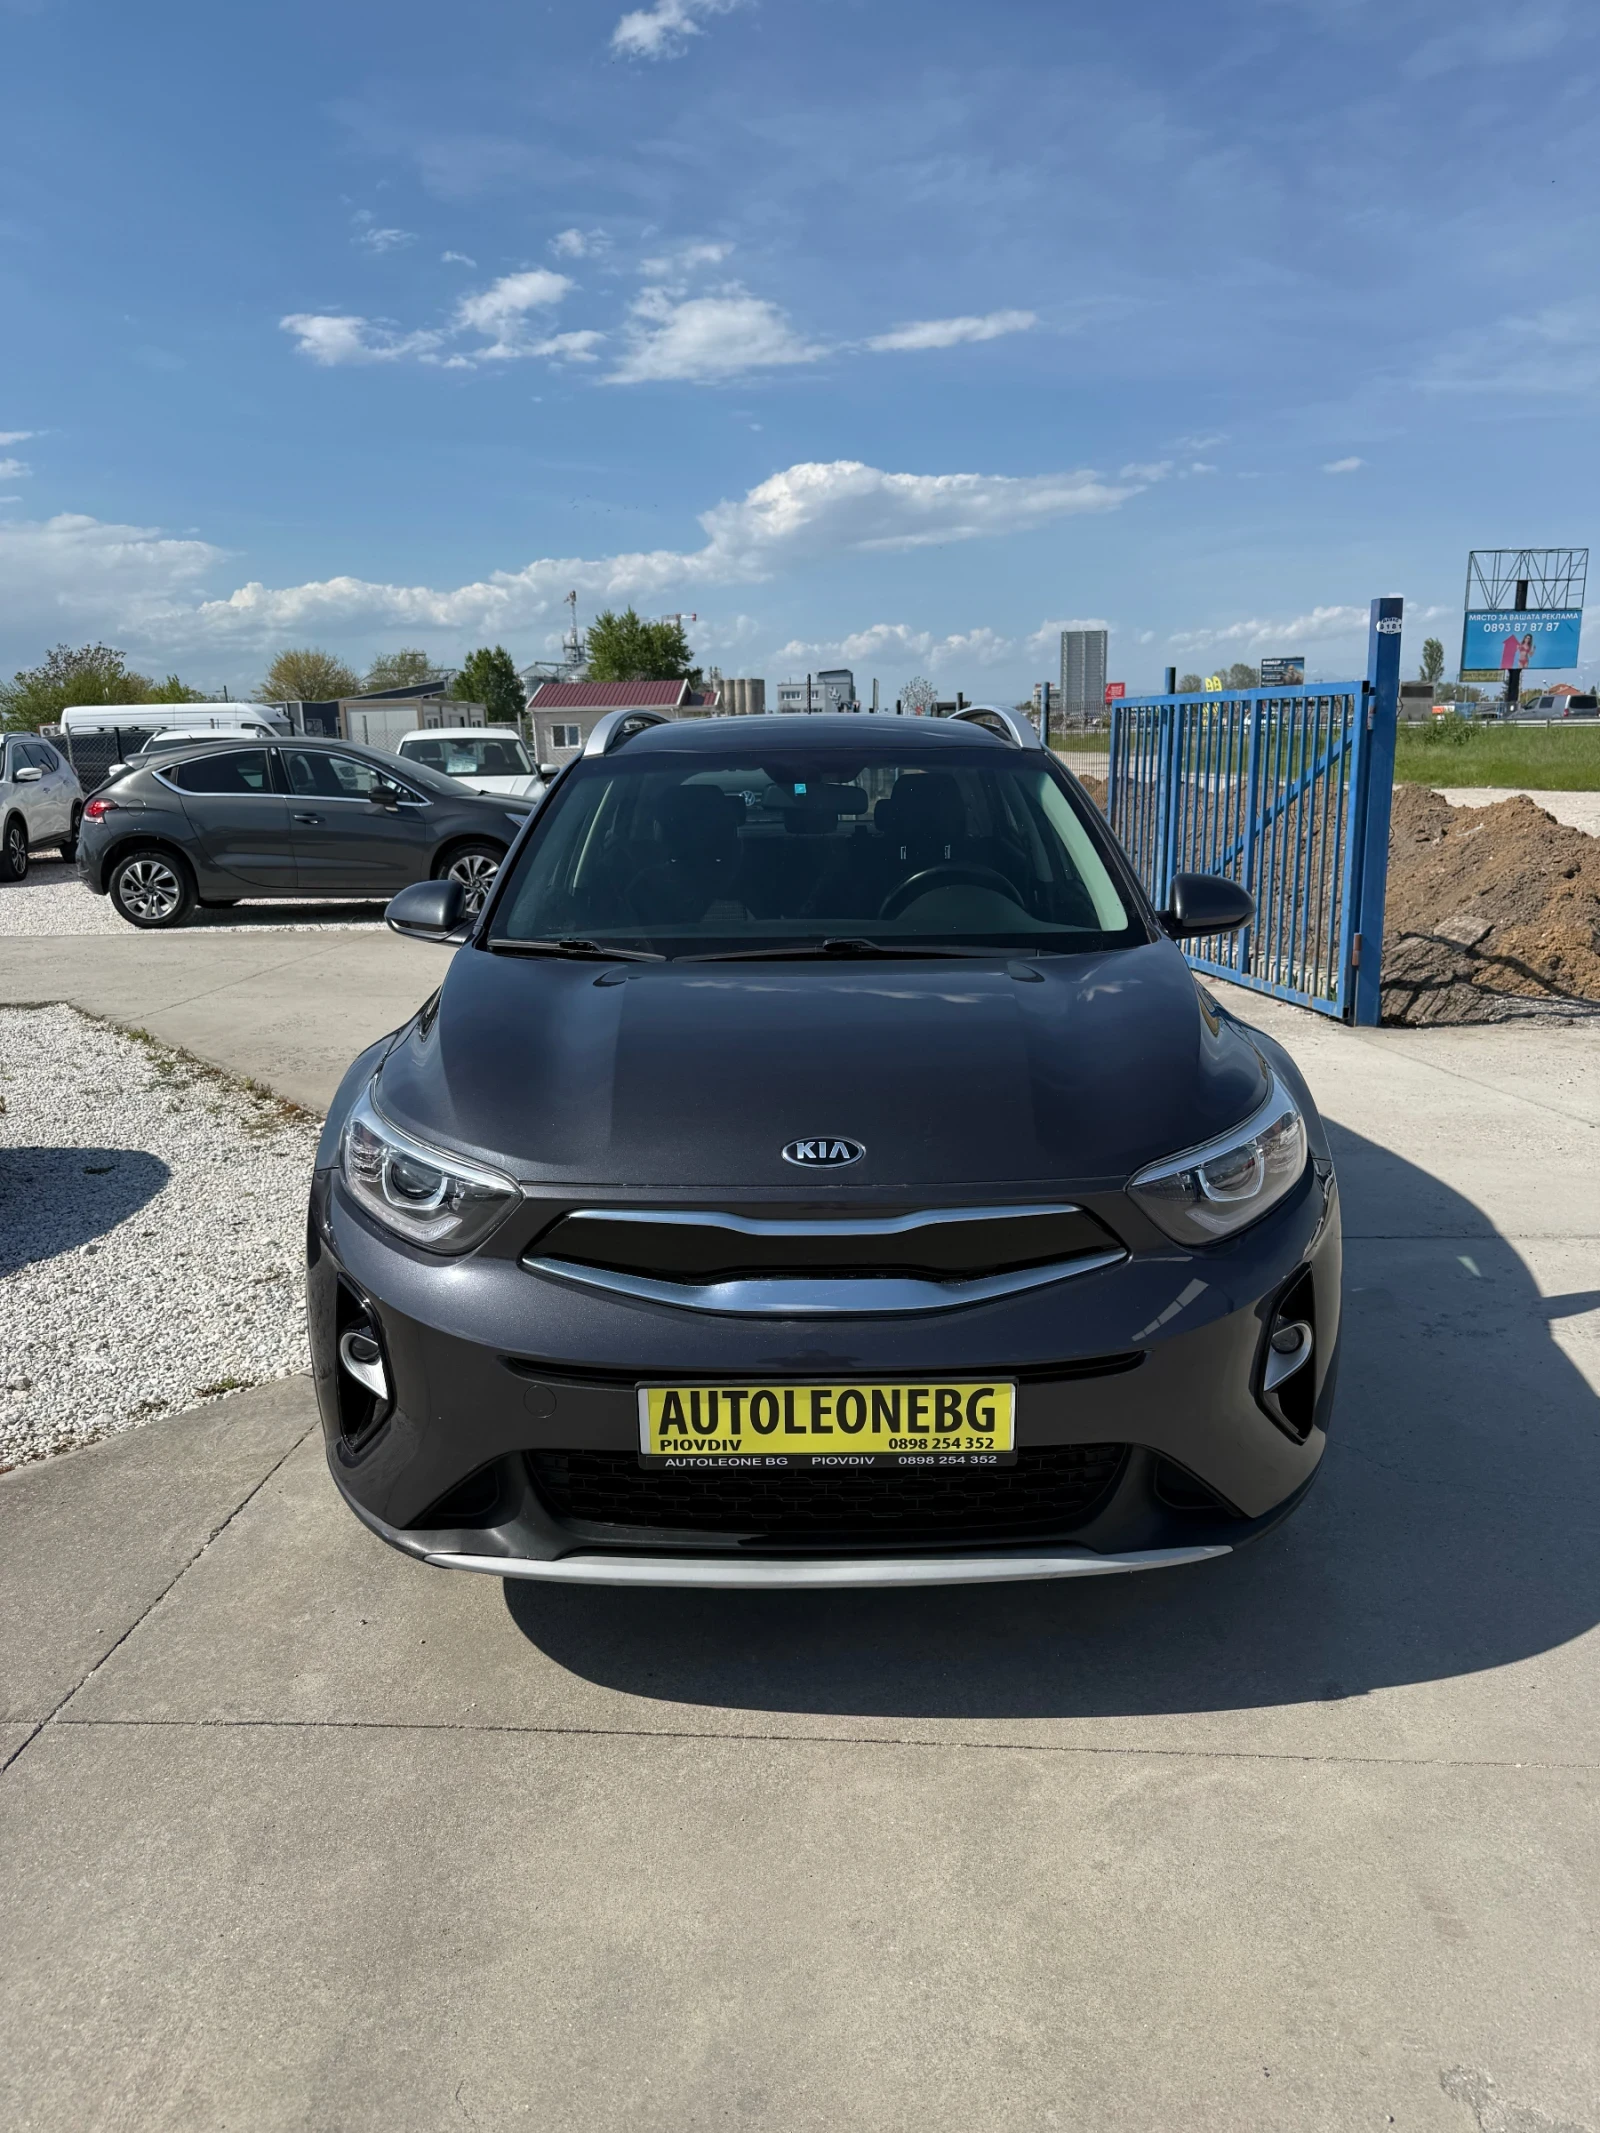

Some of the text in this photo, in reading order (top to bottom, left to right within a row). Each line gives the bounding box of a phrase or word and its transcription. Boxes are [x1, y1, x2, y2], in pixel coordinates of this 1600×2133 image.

[1542, 612, 1579, 620] РЕКЛАМА
[1483, 622, 1560, 632] 0893 87 87 87
[796, 1141, 850, 1159] KIA
[658, 1387, 996, 1436] AUTOLEONEBG
[659, 1439, 742, 1452] PIOVDIV
[888, 1437, 995, 1450] 0898 254 352
[665, 1455, 998, 1467] AUTOLEONE BG PIOVDIV 0898 254 352
